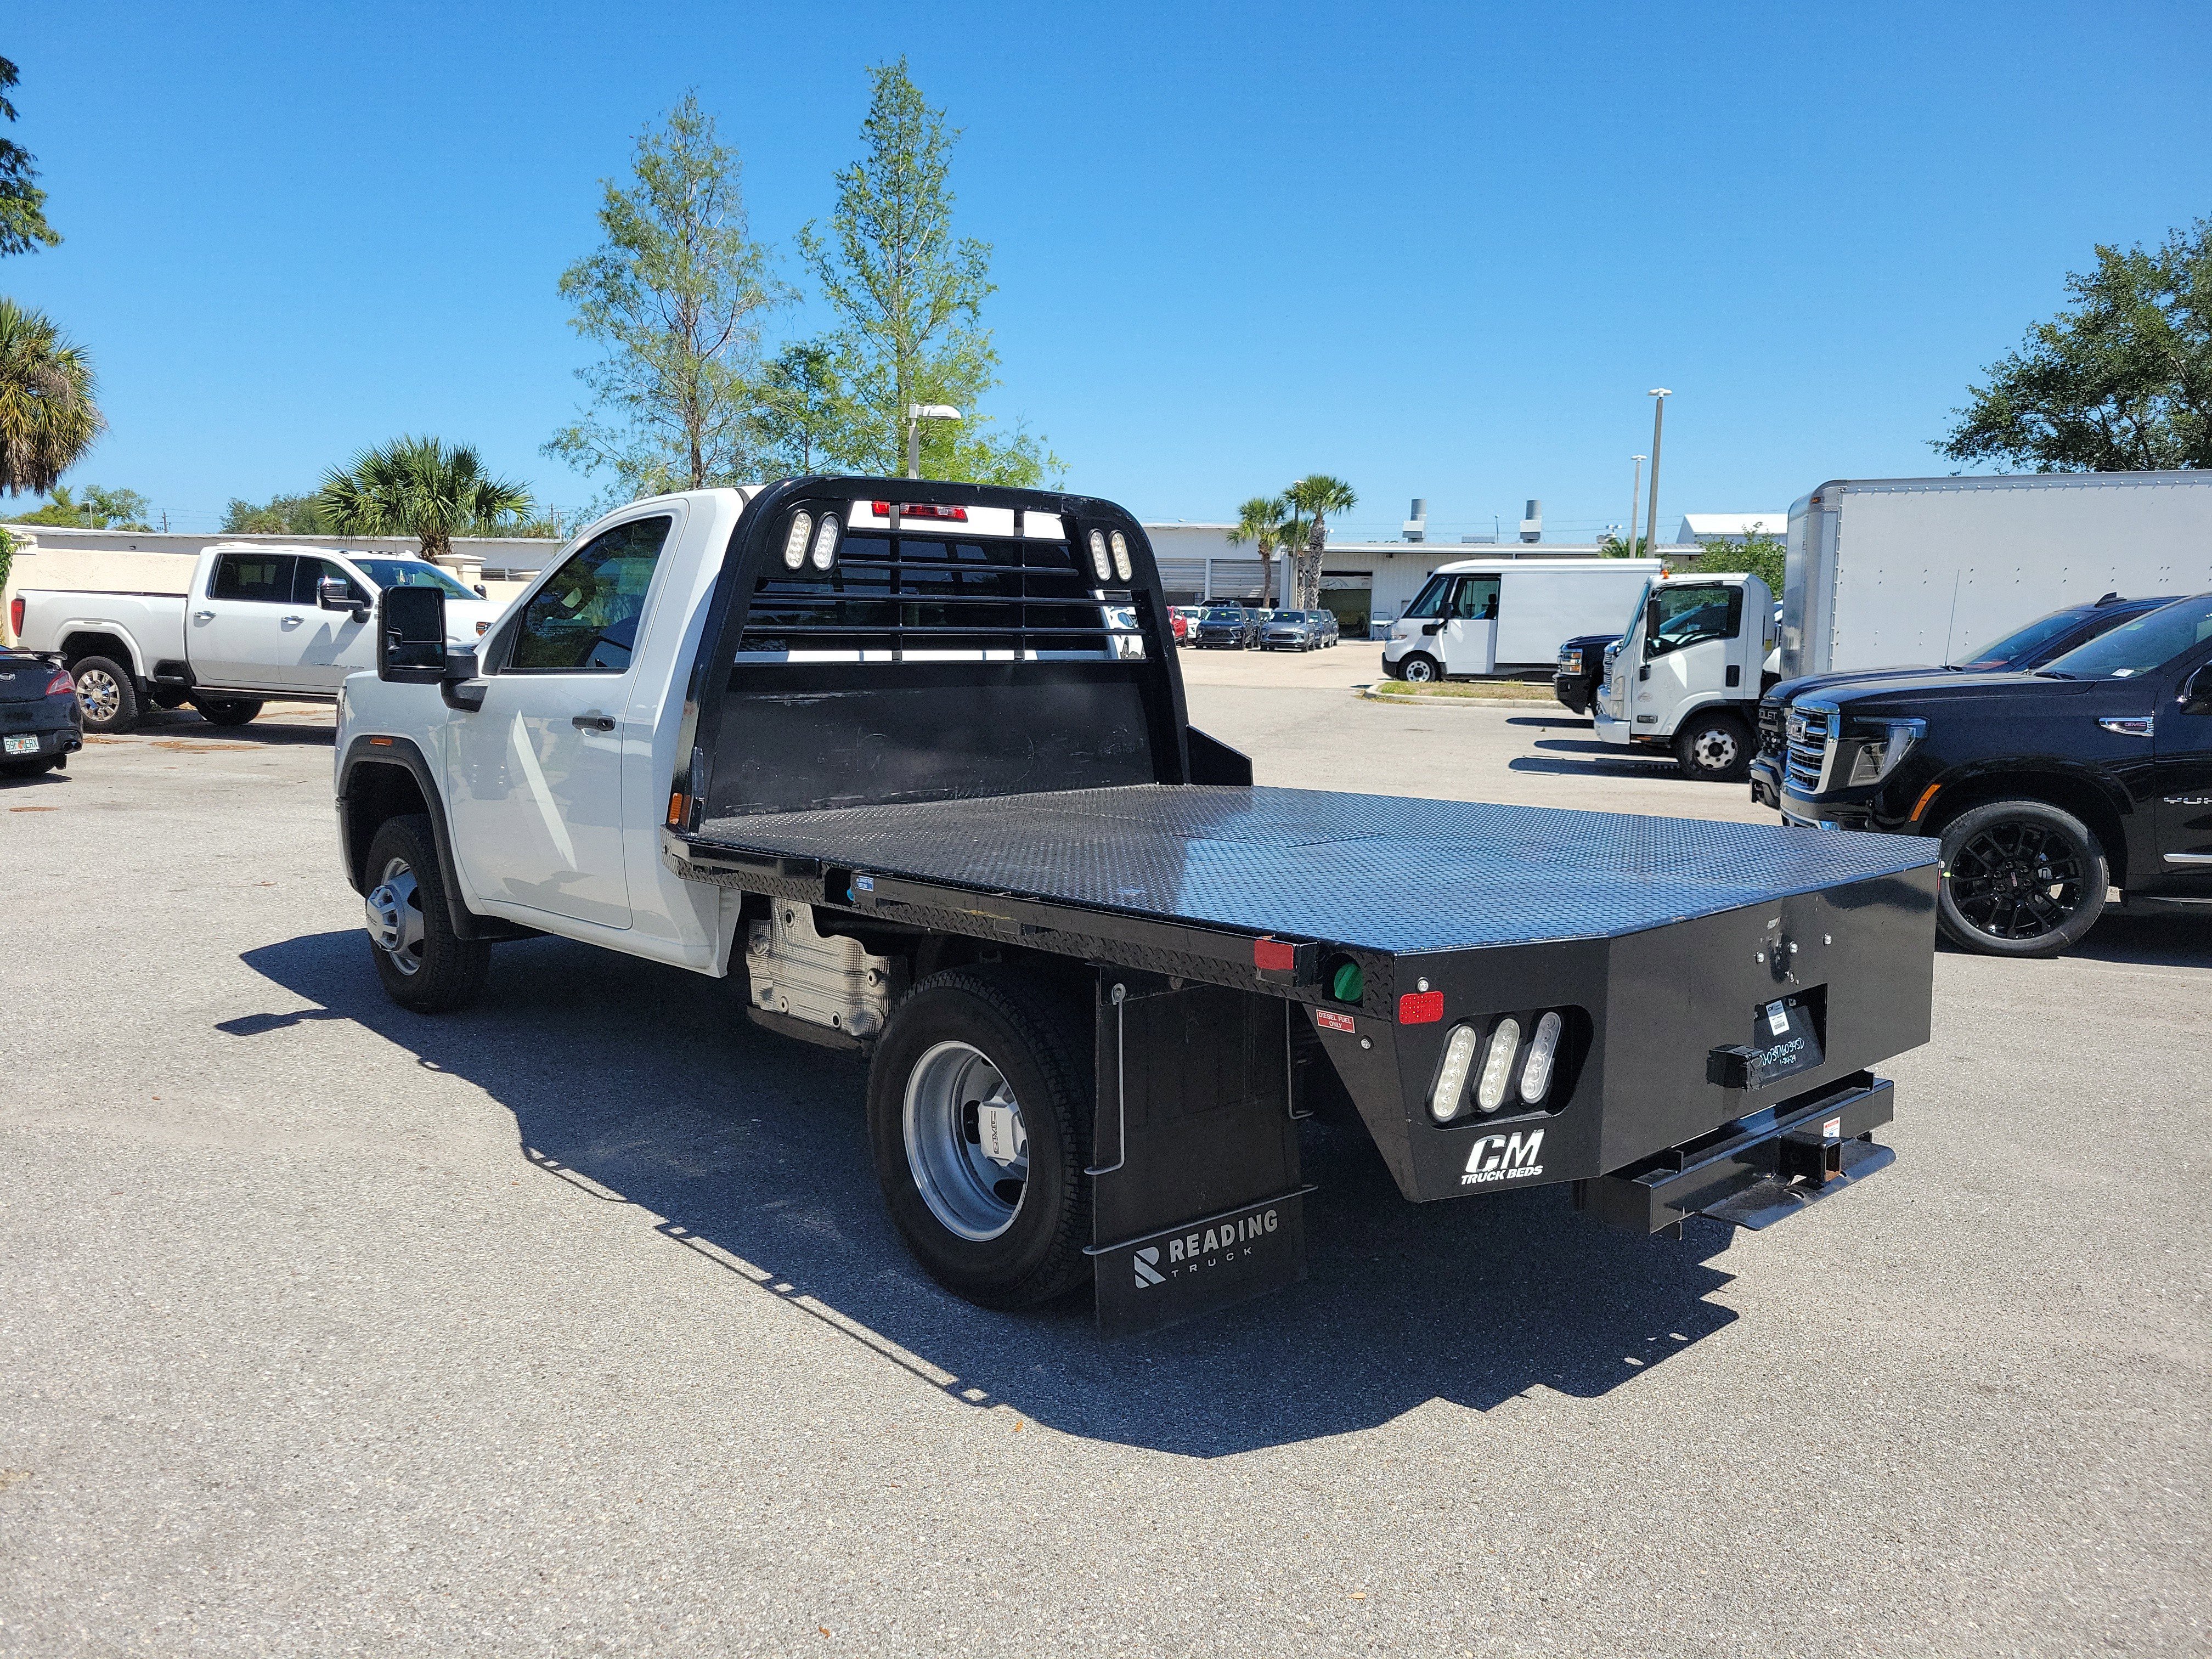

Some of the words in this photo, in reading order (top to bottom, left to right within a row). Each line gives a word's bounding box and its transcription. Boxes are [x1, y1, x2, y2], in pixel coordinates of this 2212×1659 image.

[1318, 1012, 1337, 1020] DIESEL
[1338, 1016, 1352, 1024] FUEL
[1329, 1020, 1342, 1029] ONLY
[991, 1110, 1000, 1154] GMC
[1465, 1128, 1545, 1173] CM
[1461, 1169, 1507, 1185] TRUCK
[1506, 1165, 1544, 1179] BEDS
[1170, 1209, 1278, 1263] READING
[1171, 1246, 1252, 1278] TRUCK
